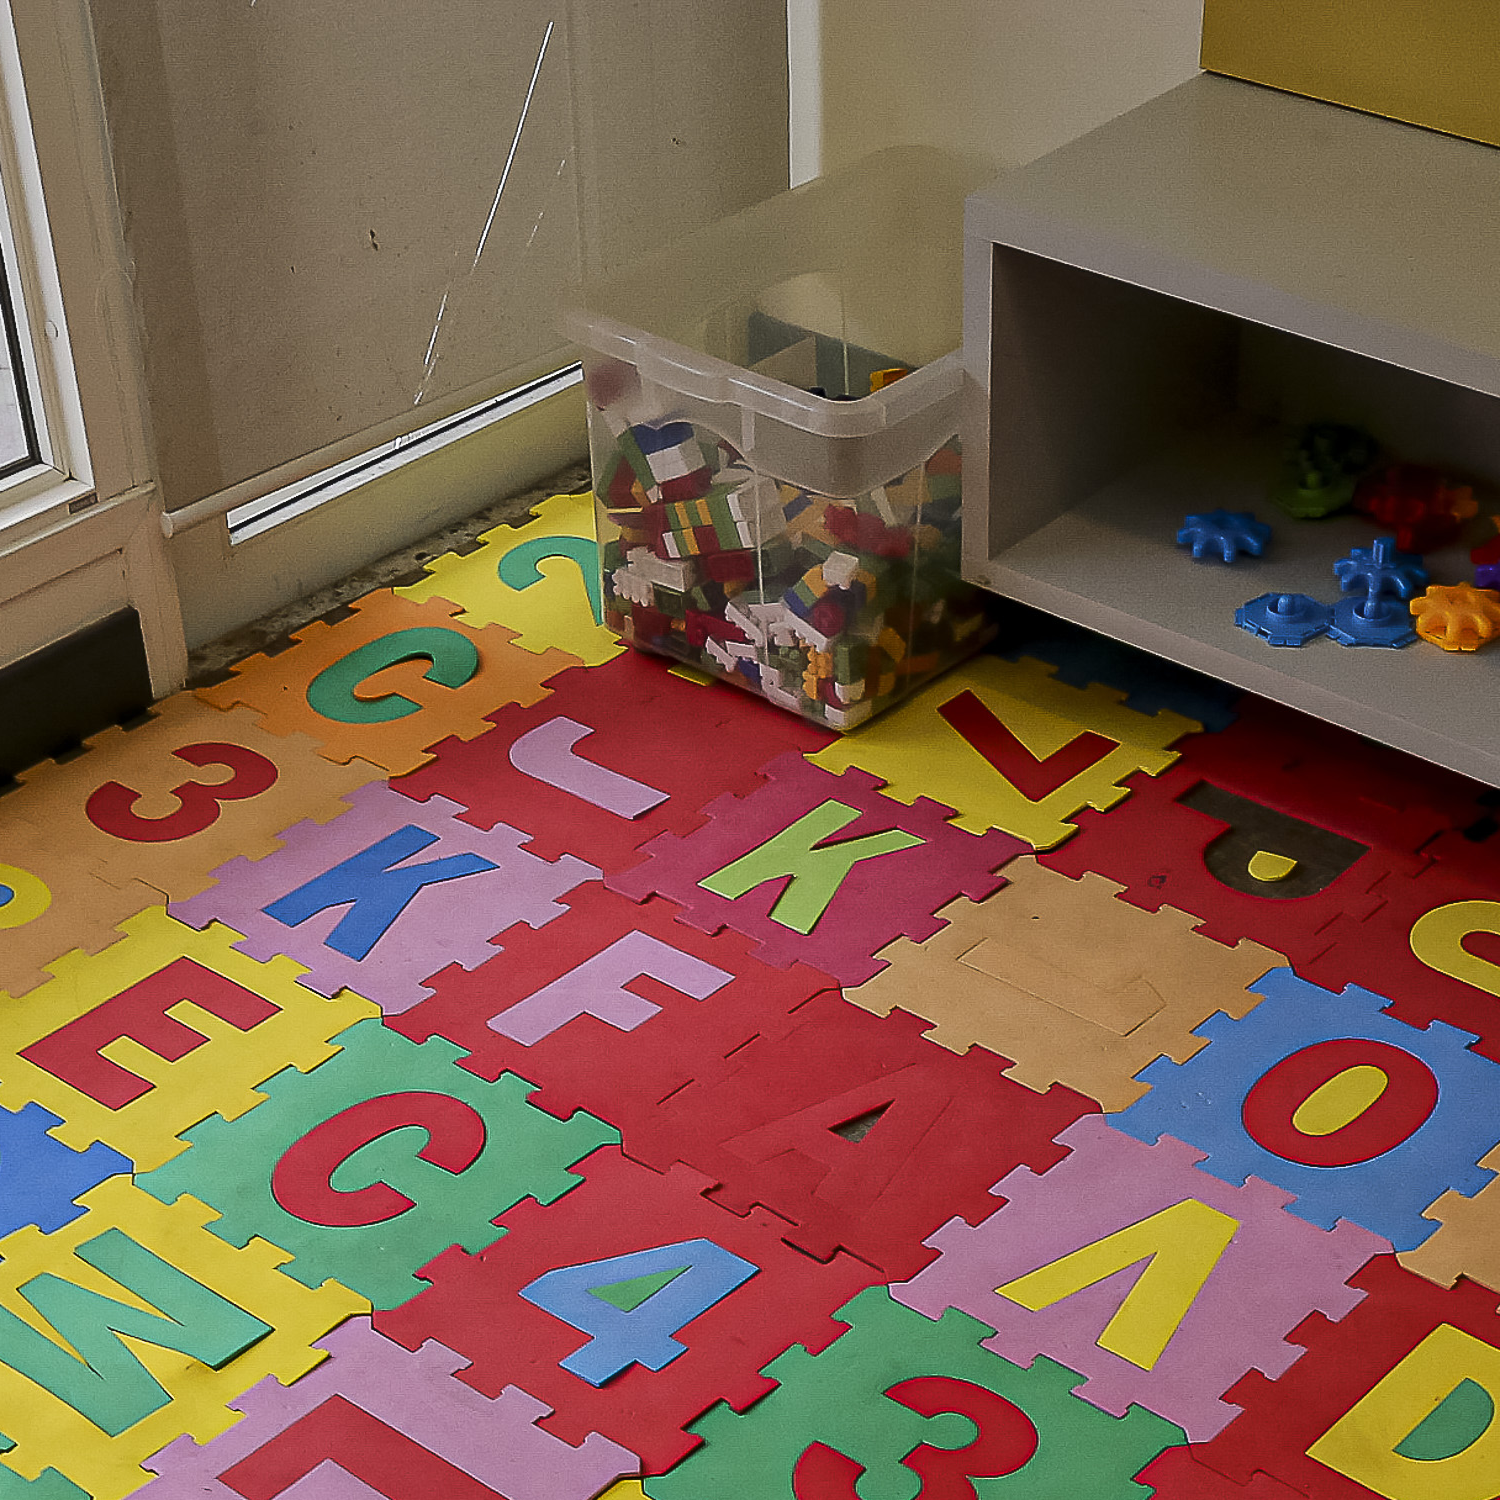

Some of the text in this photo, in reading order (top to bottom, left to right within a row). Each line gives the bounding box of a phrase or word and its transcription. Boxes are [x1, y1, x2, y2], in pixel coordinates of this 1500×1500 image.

[307, 626, 479, 723] C
[85, 741, 278, 842] 3
[263, 824, 499, 959] K
[698, 800, 926, 933] K
[20, 956, 282, 1110] E
[487, 930, 734, 1046] F
[271, 1091, 485, 1227] C
[717, 1064, 952, 1210] A
[520, 1238, 759, 1388] 4
